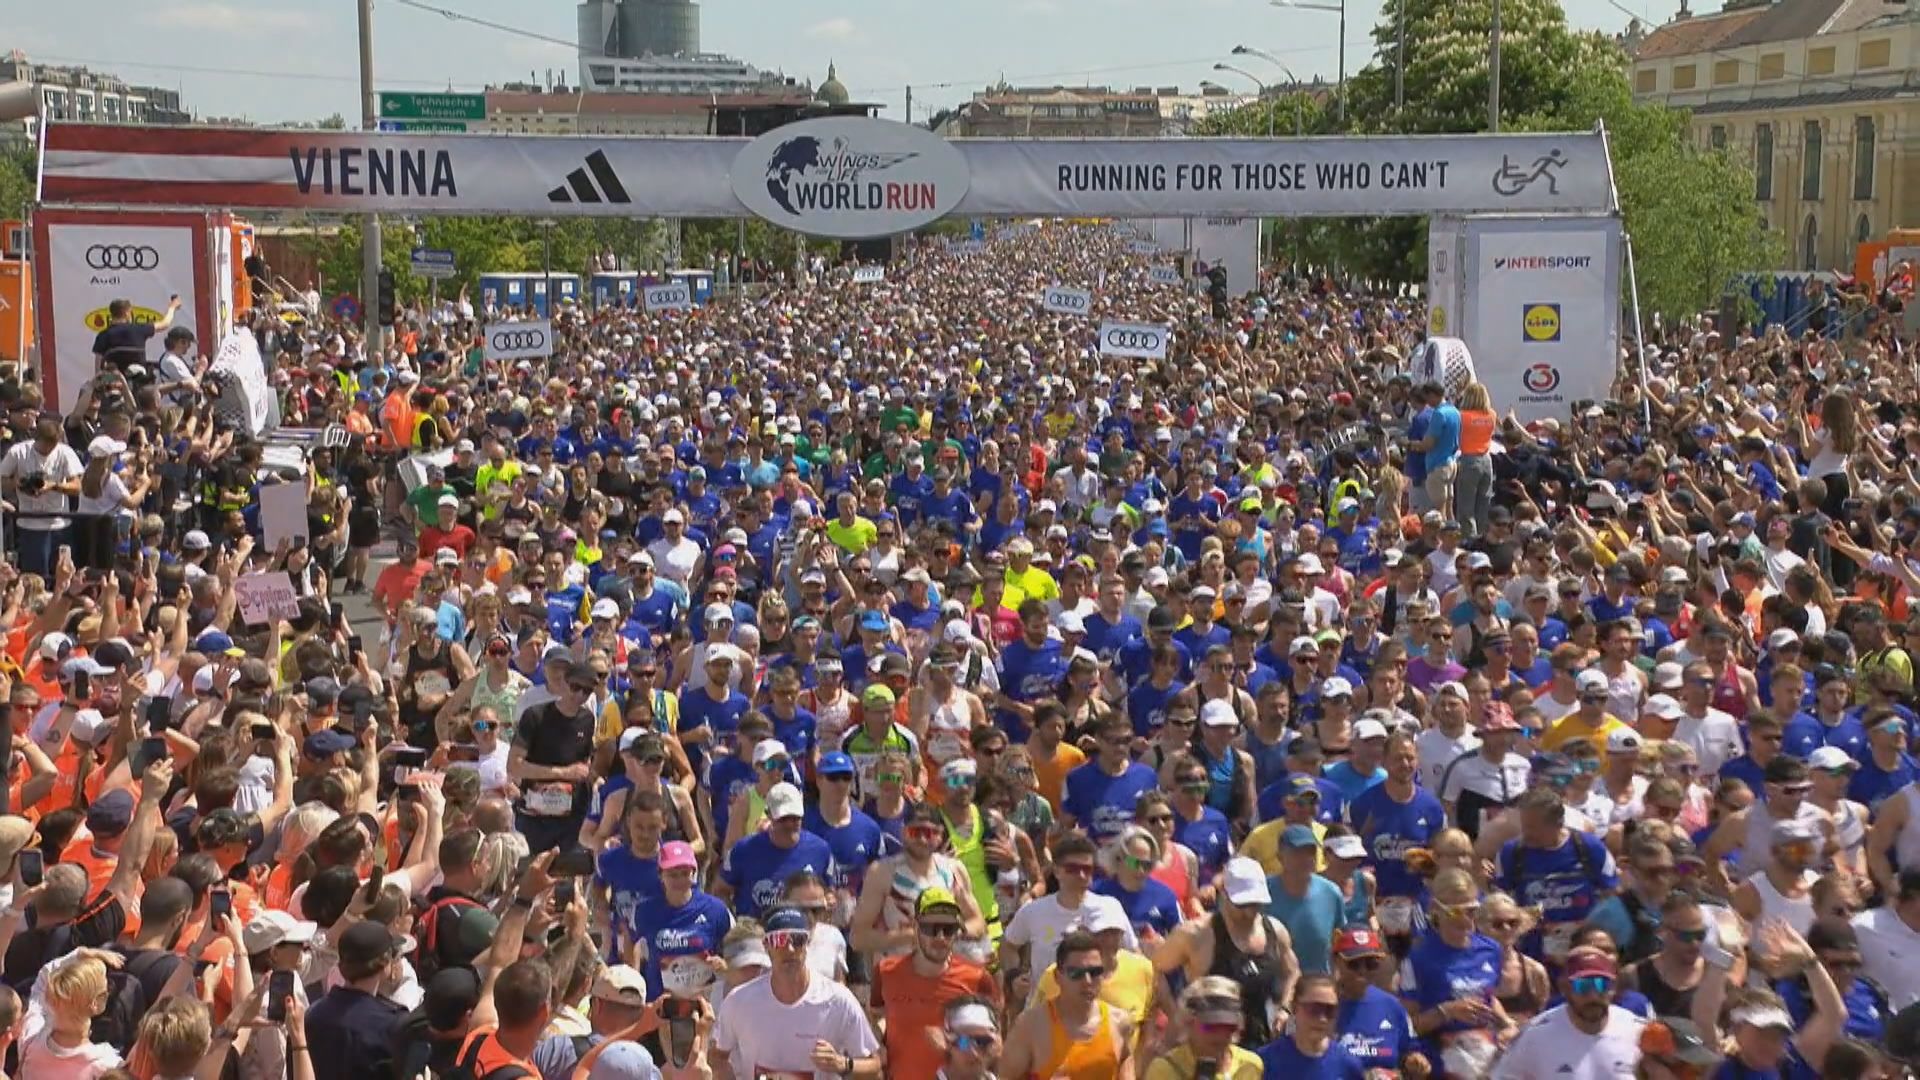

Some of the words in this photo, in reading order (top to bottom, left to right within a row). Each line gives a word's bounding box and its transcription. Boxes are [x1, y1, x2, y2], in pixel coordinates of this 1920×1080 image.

[410, 96, 476, 107] Technisches
[421, 107, 466, 117] Museum
[818, 154, 880, 169] WINGS
[289, 146, 458, 197] VIENNA
[827, 168, 860, 182] LIFE
[1058, 163, 1166, 191] RUNNING
[1176, 163, 1223, 190] FOR
[1231, 162, 1307, 190] THOSE
[1316, 163, 1371, 190] WHO
[1380, 161, 1450, 189] CAN'T
[1506, 255, 1592, 269] INTERSPORT
[90, 275, 121, 285] Audi
